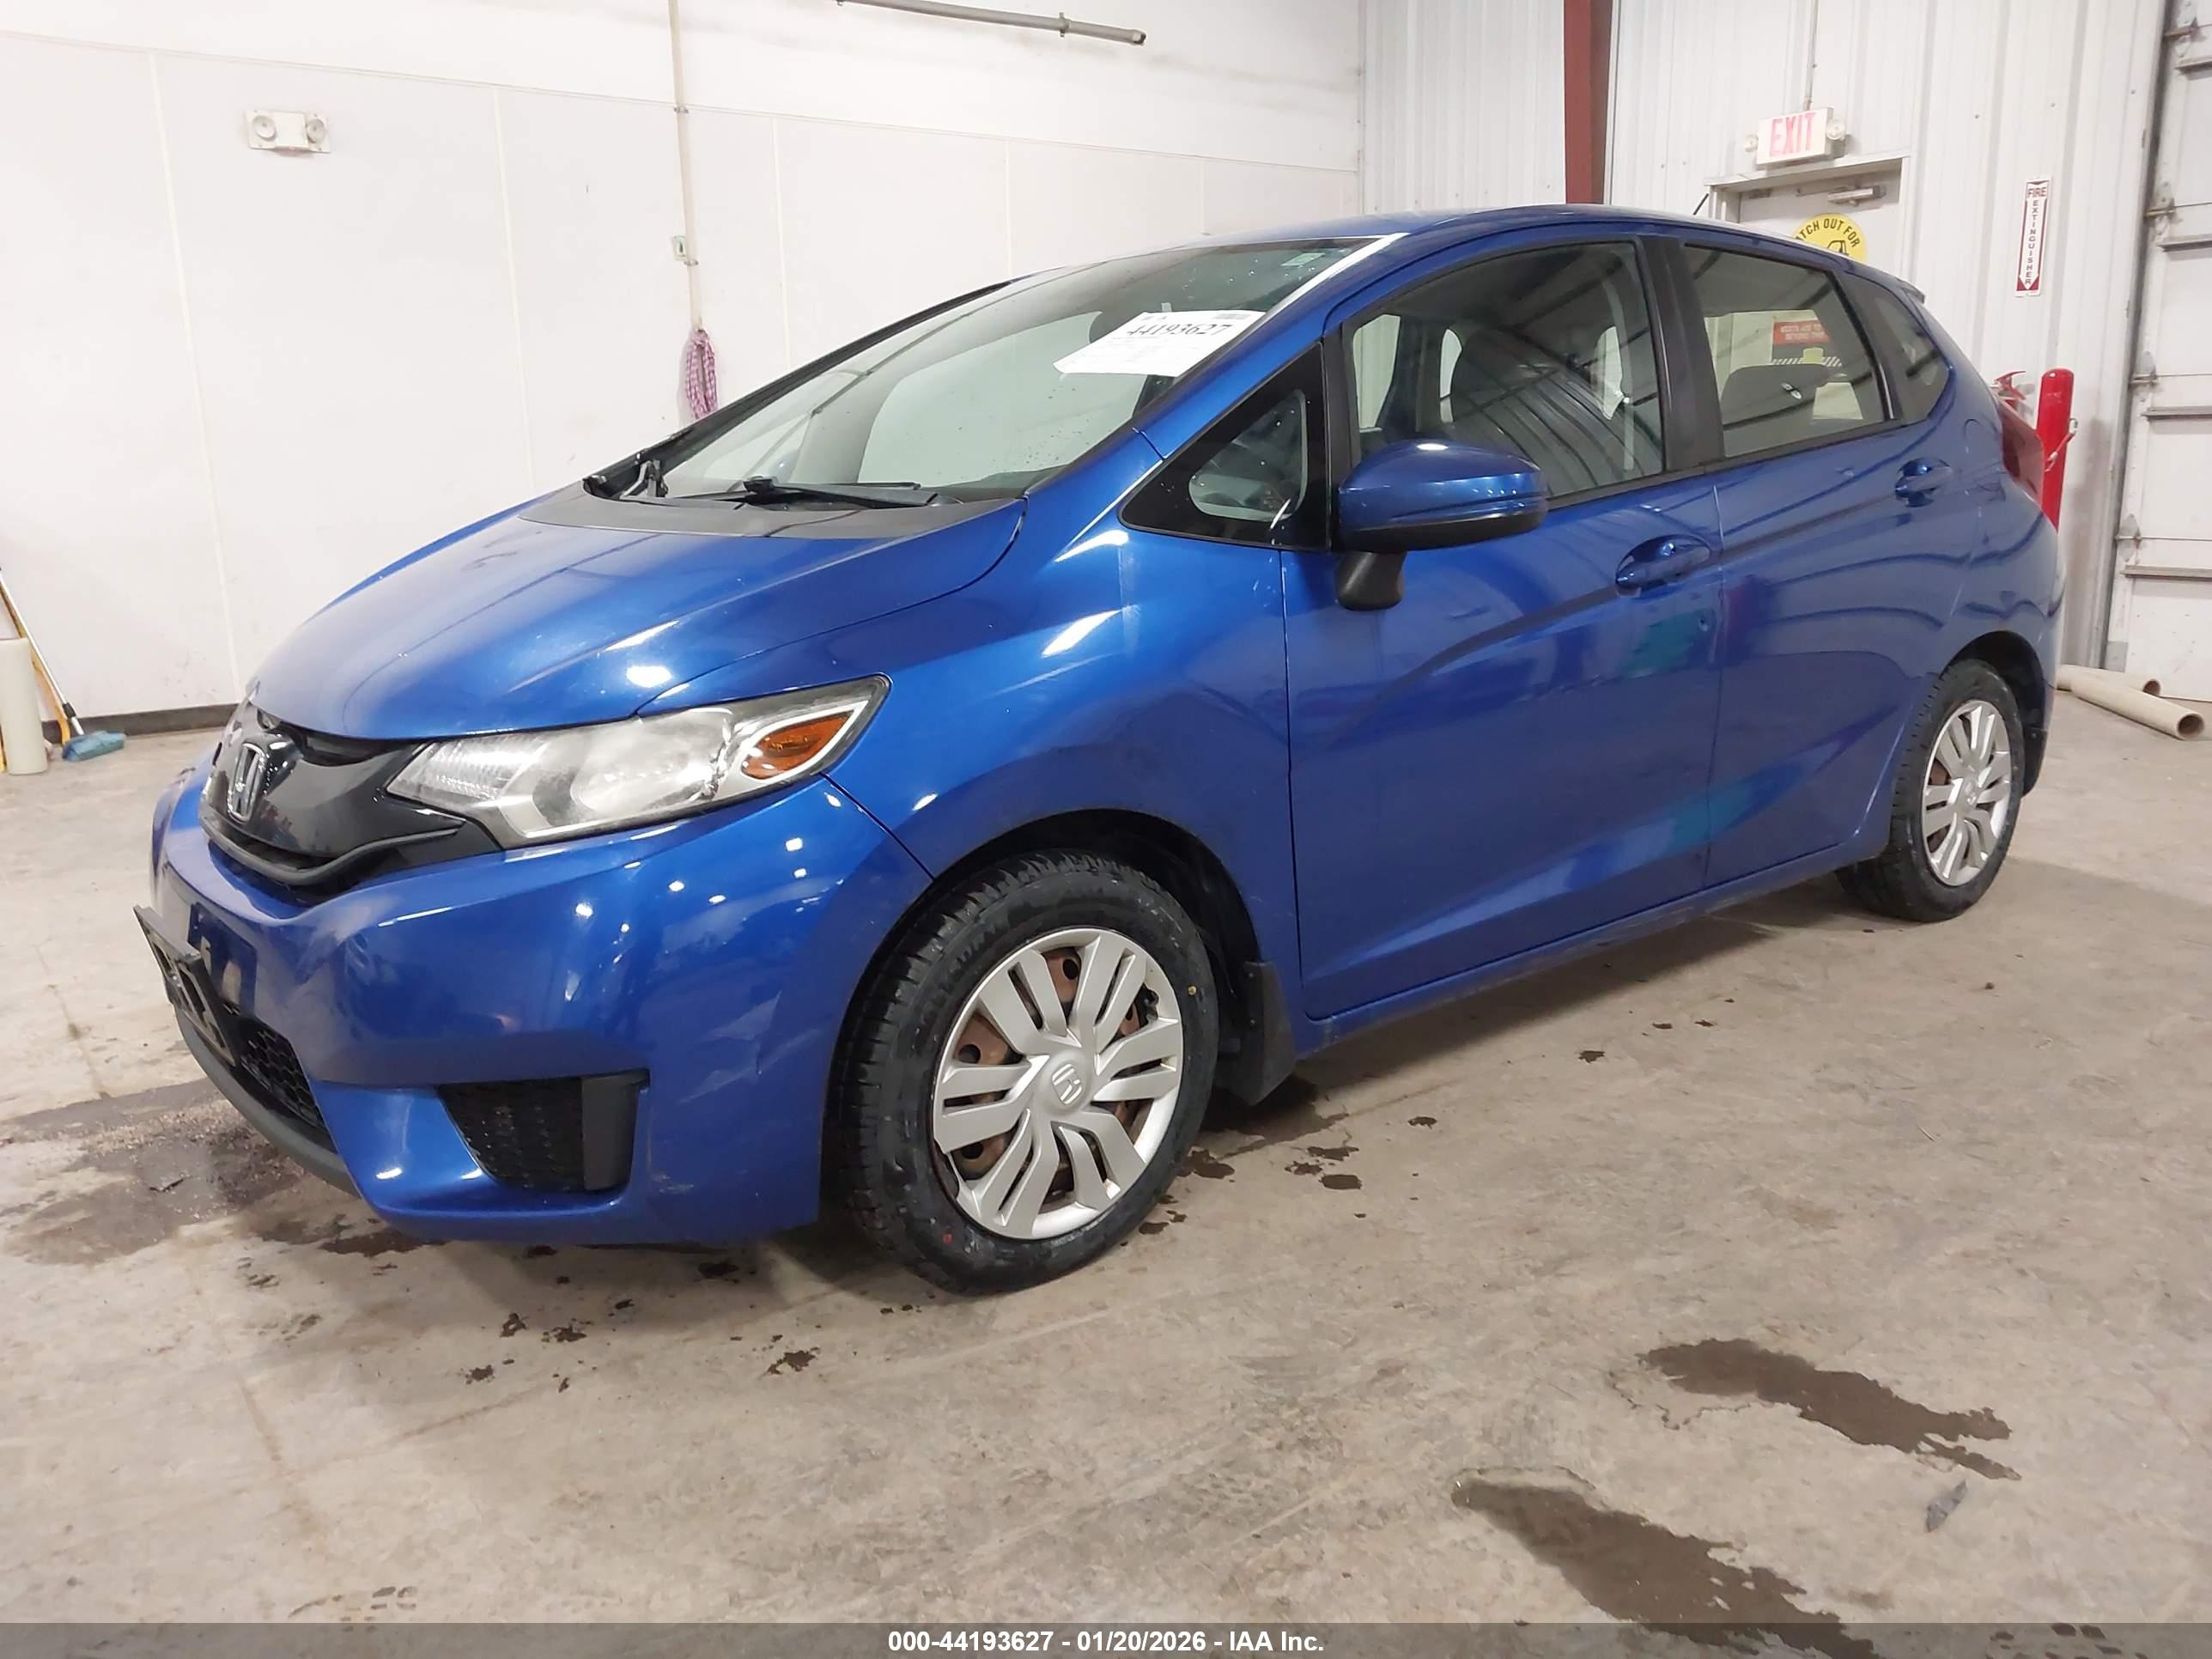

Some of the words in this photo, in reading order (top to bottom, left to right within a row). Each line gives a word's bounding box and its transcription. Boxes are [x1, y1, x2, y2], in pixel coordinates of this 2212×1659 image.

[1770, 112, 1816, 157] EXIT
[2027, 185, 2047, 198] FIRE
[1796, 220, 1820, 240] TCH
[1823, 218, 1844, 231] OUT
[1843, 225, 1861, 248] FOR
[2025, 199, 2039, 285] EXTINGUISHER
[1126, 323, 1234, 336] 44193627
